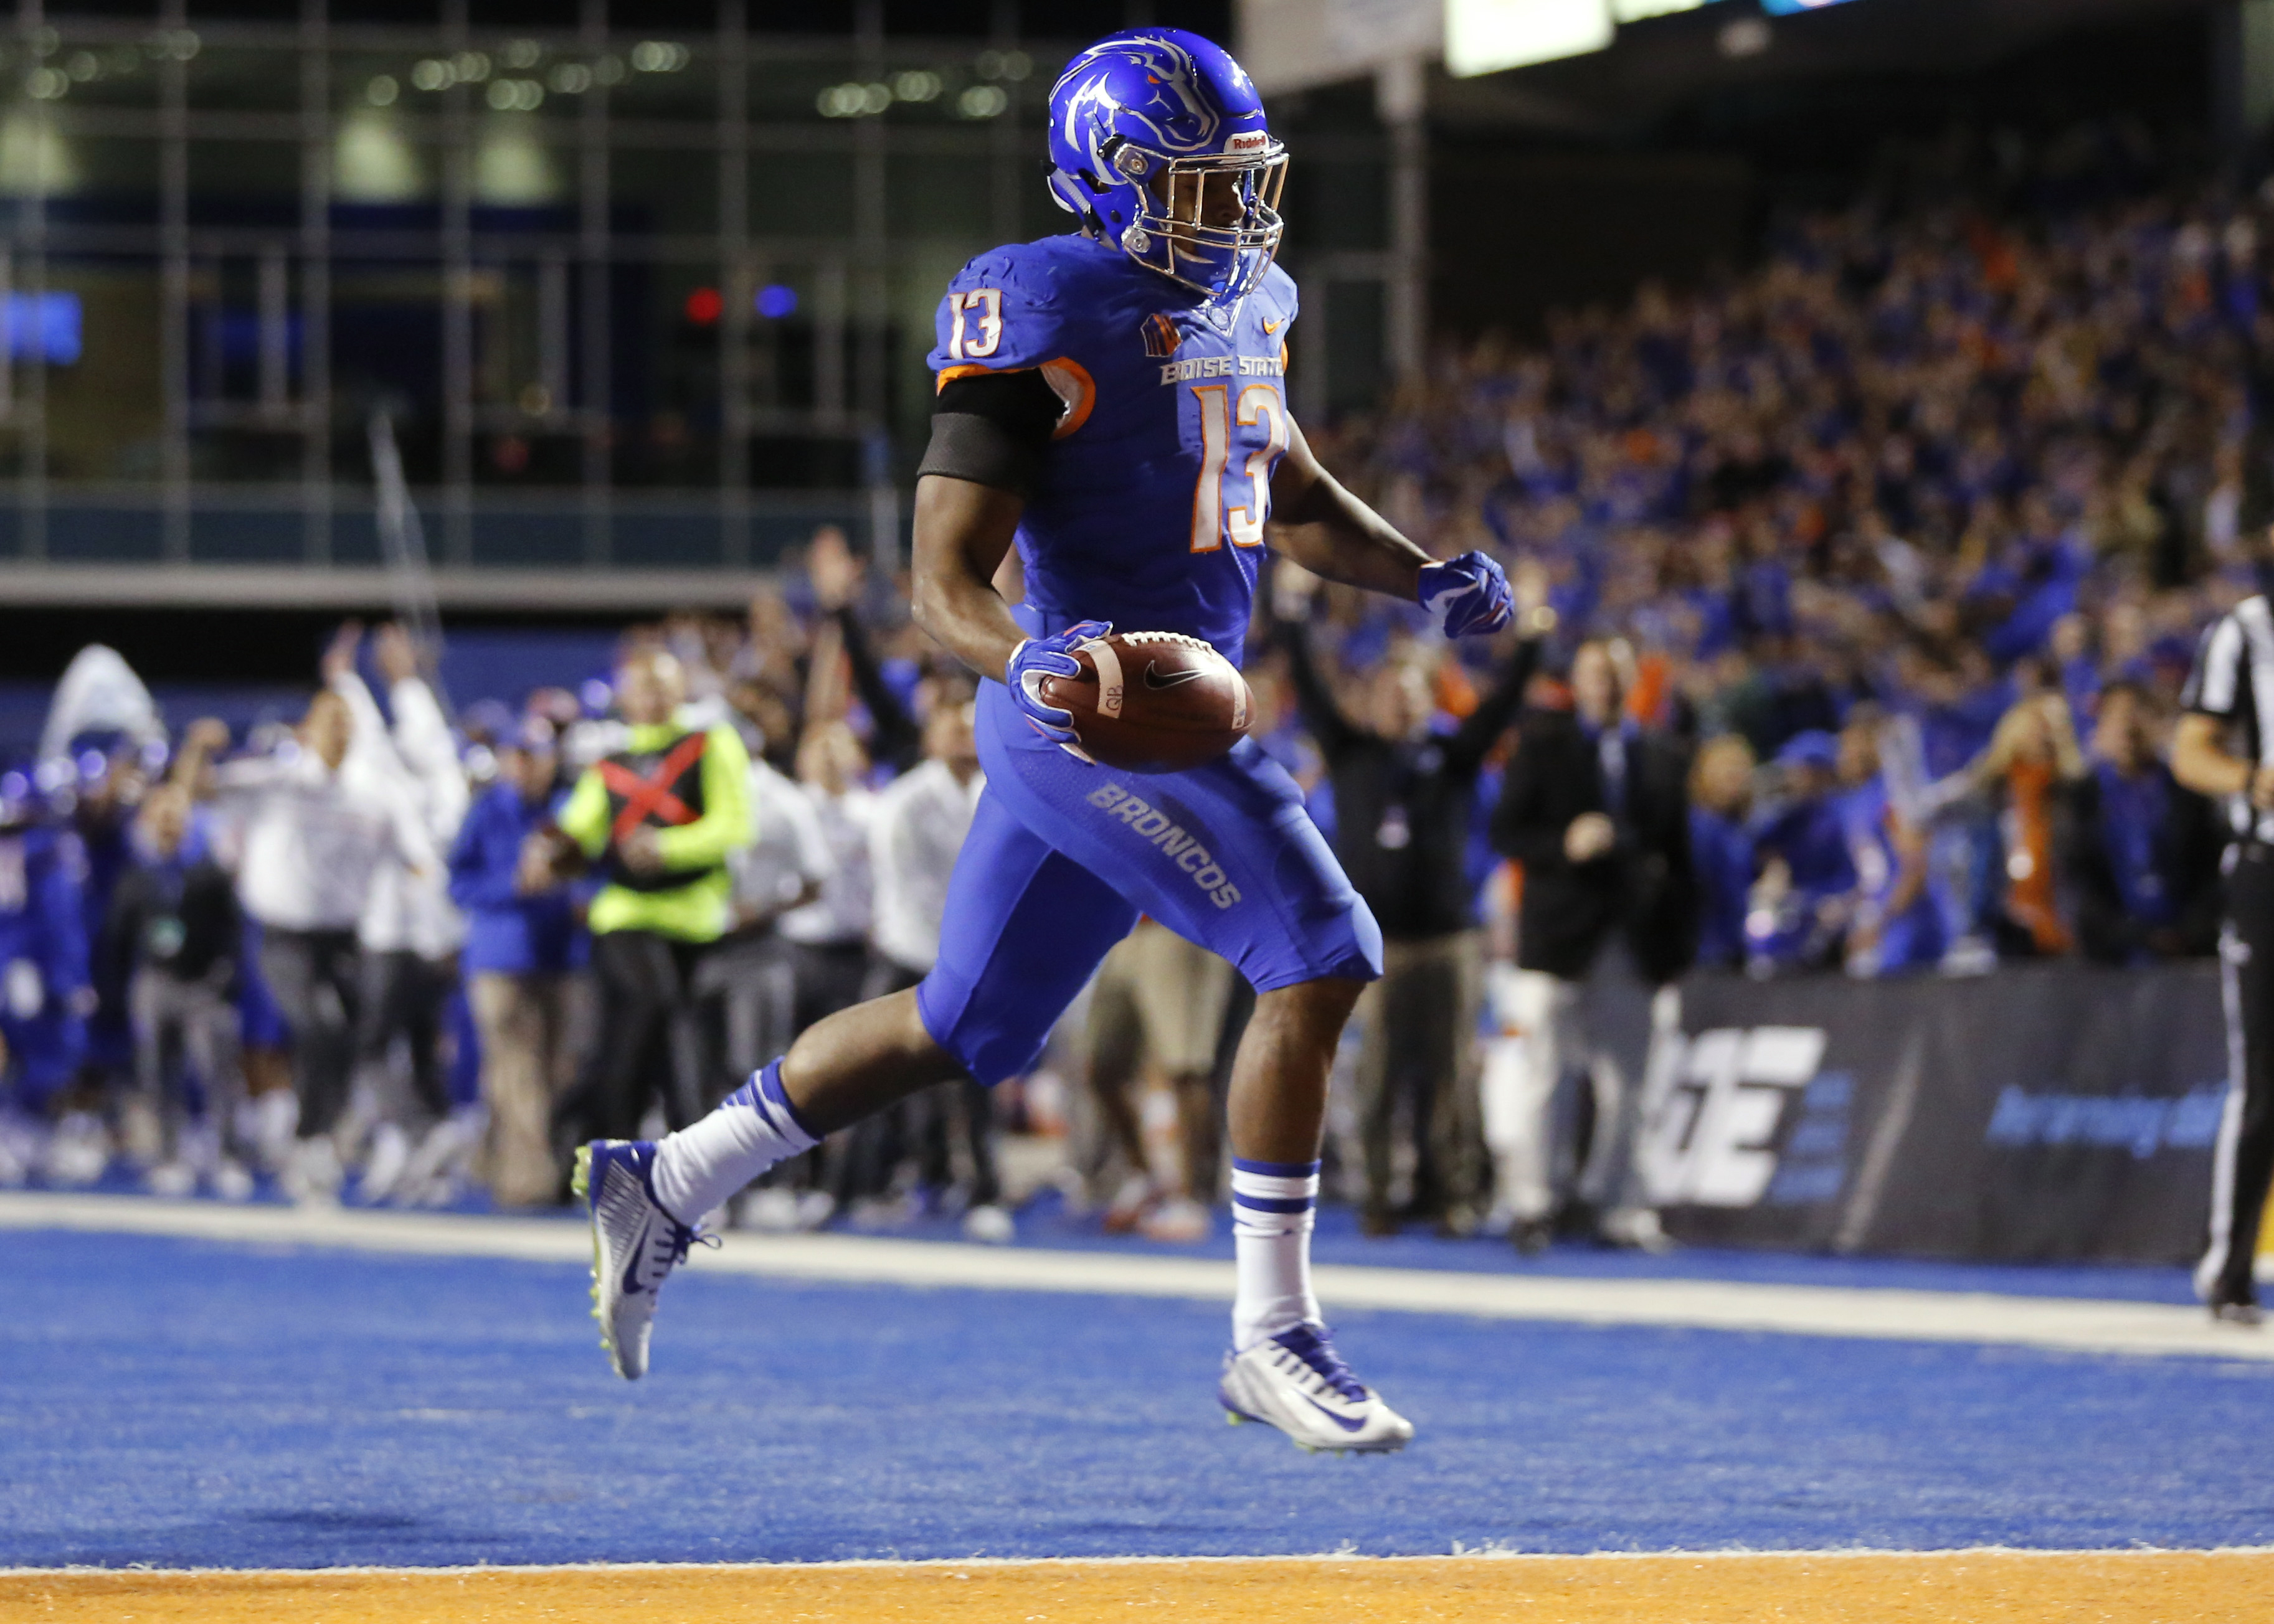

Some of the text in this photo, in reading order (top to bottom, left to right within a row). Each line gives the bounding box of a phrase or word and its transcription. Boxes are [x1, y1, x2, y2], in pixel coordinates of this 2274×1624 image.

[949, 288, 1003, 359] 13
[1160, 355, 1233, 385] BOISE
[1190, 384, 1286, 553] 13
[1086, 782, 1241, 909] BRONCOS
